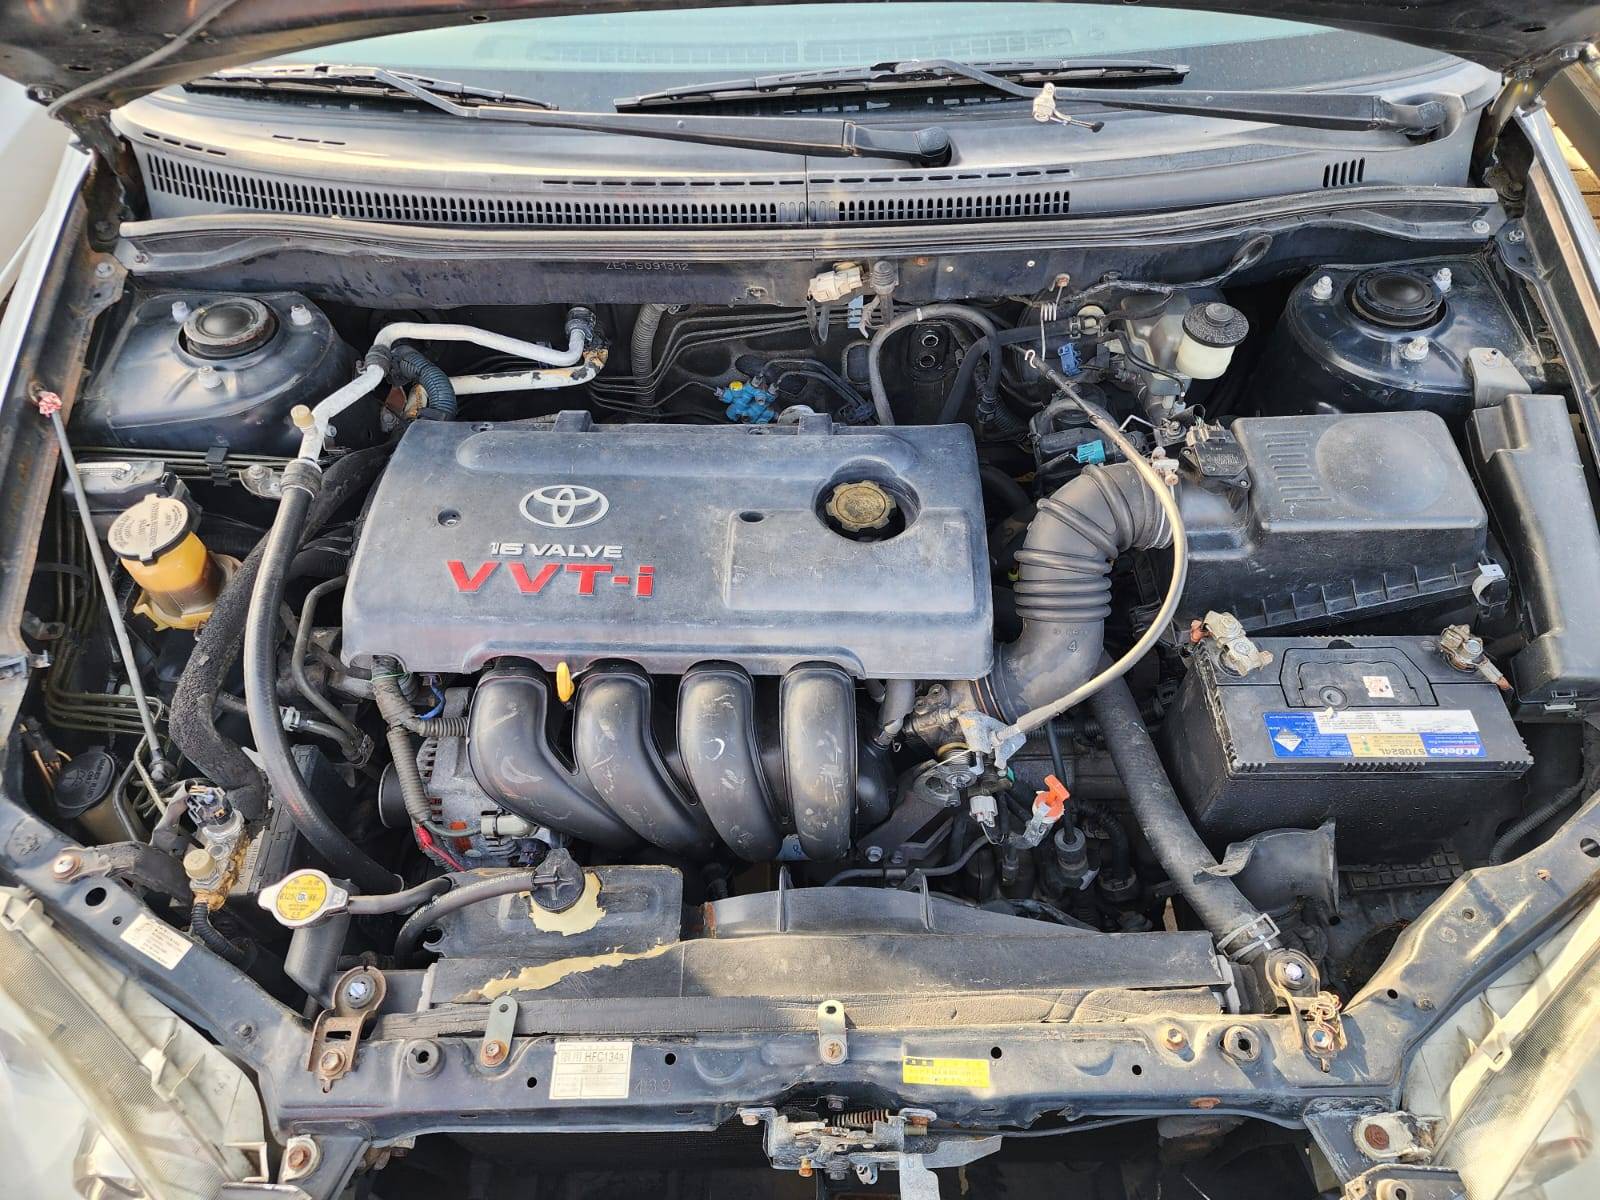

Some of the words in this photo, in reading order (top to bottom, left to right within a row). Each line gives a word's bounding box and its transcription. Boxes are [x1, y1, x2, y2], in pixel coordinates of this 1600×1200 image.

[489, 542, 526, 557] 16
[529, 543, 624, 559] VALVE
[446, 559, 657, 597] VVT-i
